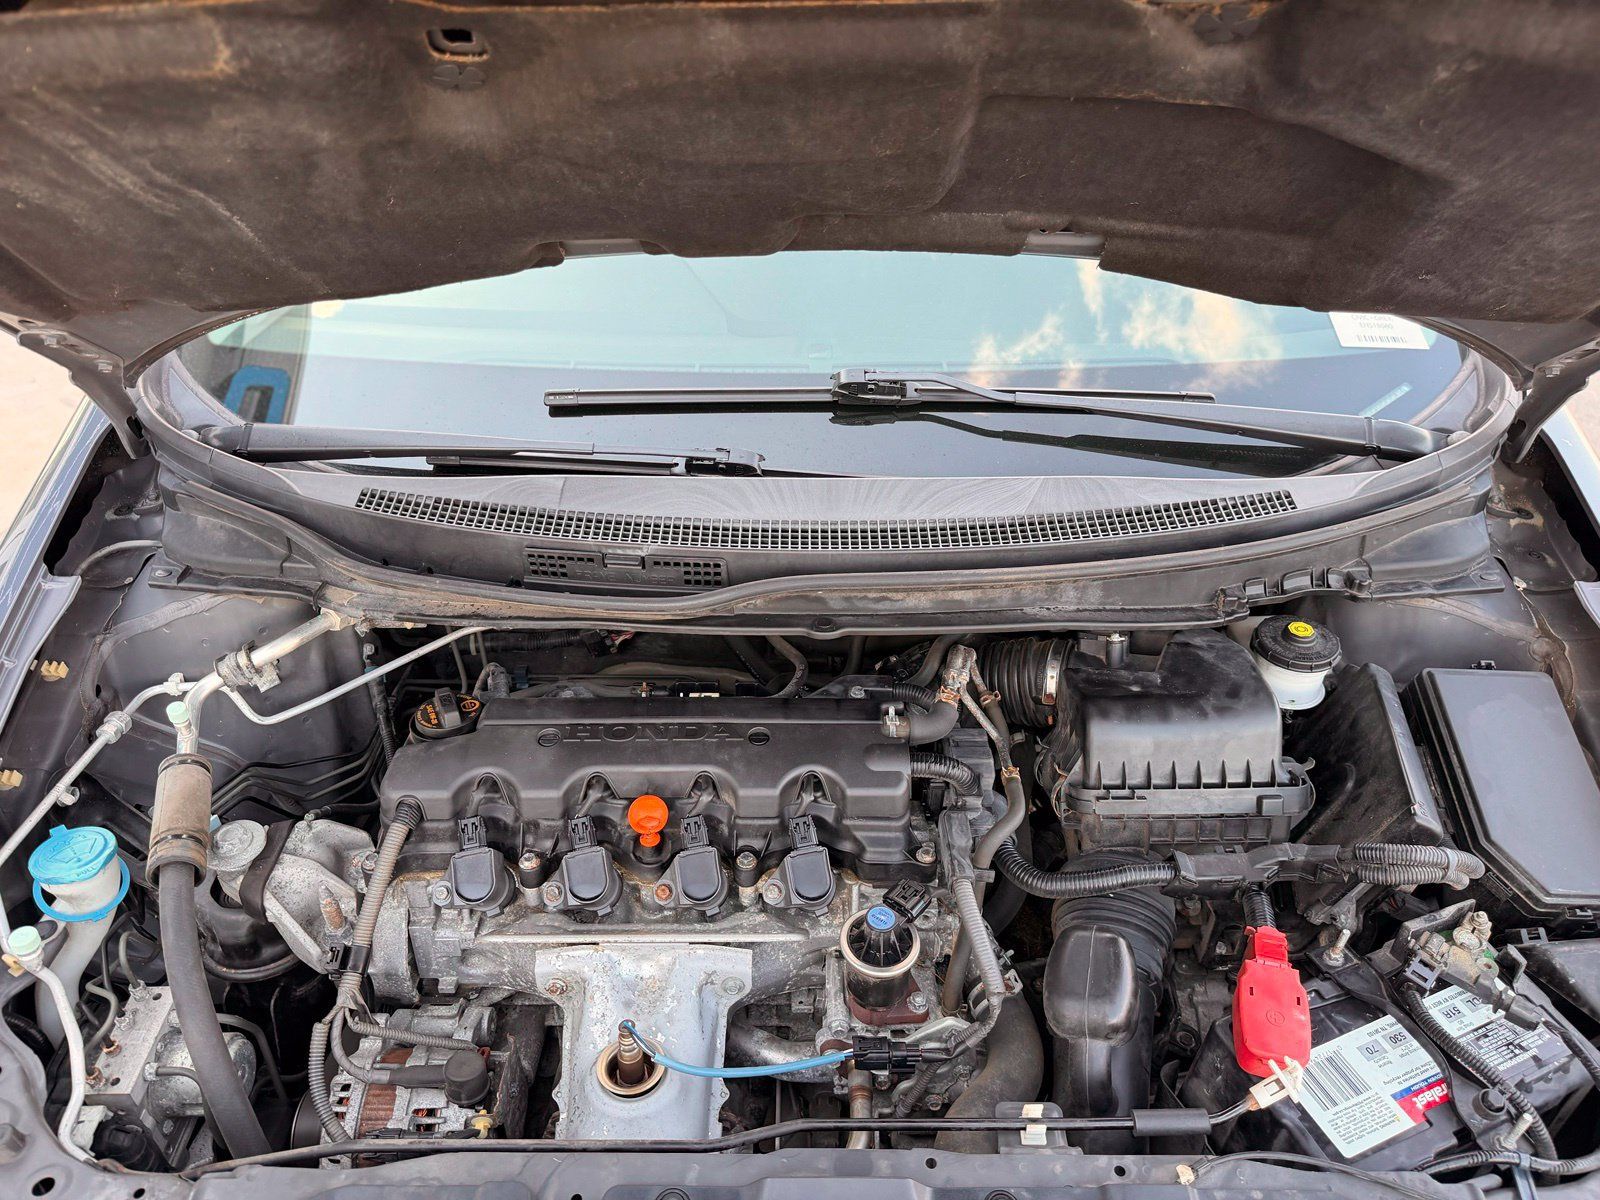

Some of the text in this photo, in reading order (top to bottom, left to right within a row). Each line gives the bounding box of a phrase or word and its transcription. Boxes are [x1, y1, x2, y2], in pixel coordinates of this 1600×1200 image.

[563, 725, 745, 742] HONDA
[1441, 1006, 1461, 1019] 51R
[1387, 1031, 1407, 1044] 530
[1364, 1044, 1379, 1055] 70
[1381, 1074, 1401, 1086] recycling
[1401, 1072, 1420, 1083] batteries
[1409, 1080, 1428, 1091] TOUGH
